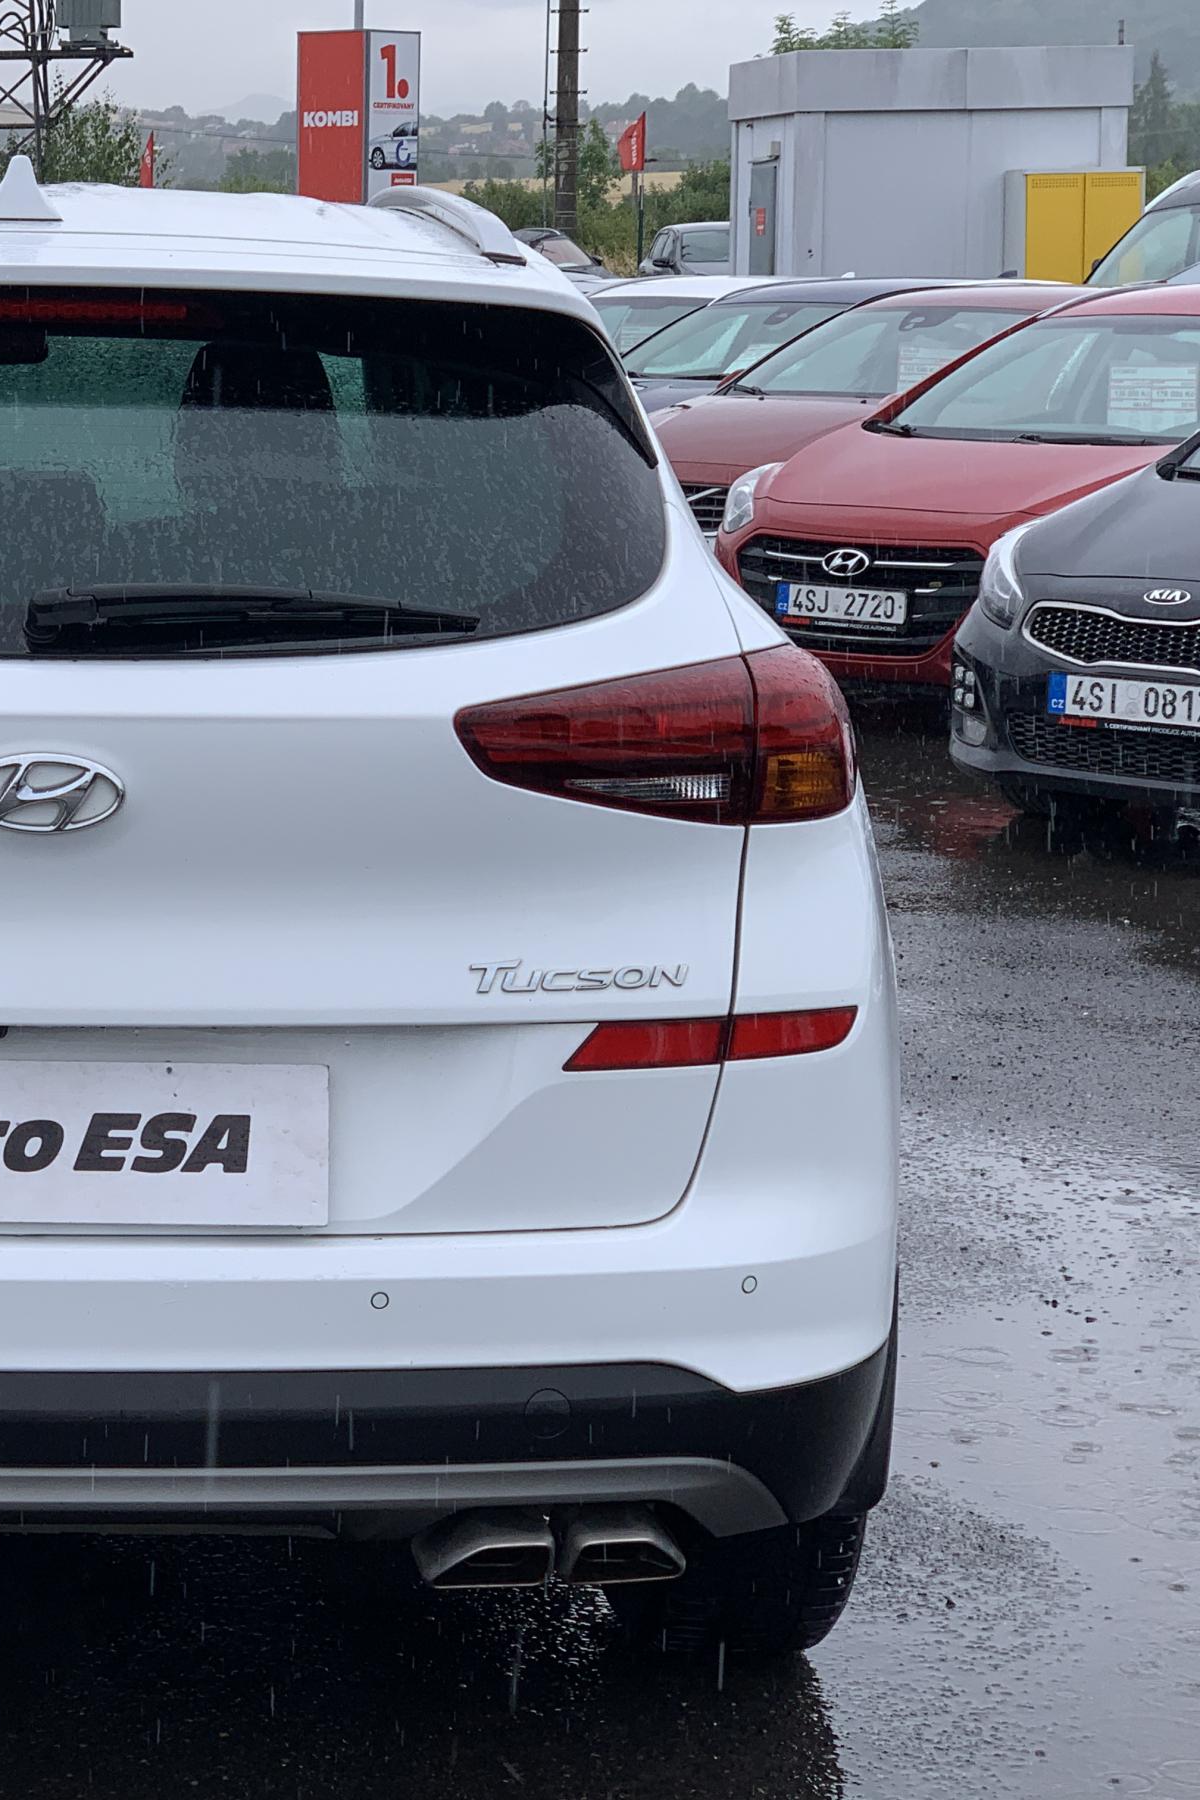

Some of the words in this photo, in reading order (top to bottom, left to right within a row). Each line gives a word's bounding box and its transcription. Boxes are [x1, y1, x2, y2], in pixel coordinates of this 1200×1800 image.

[303, 110, 359, 128] KOMBI
[792, 588, 829, 613] 4SJ
[844, 592, 895, 619] 2720
[1149, 589, 1182, 601] KIA
[1051, 698, 1065, 709] CZ
[1072, 680, 1117, 714] 4SI
[1143, 686, 1200, 723] 081
[72, 1112, 251, 1174] ESA
